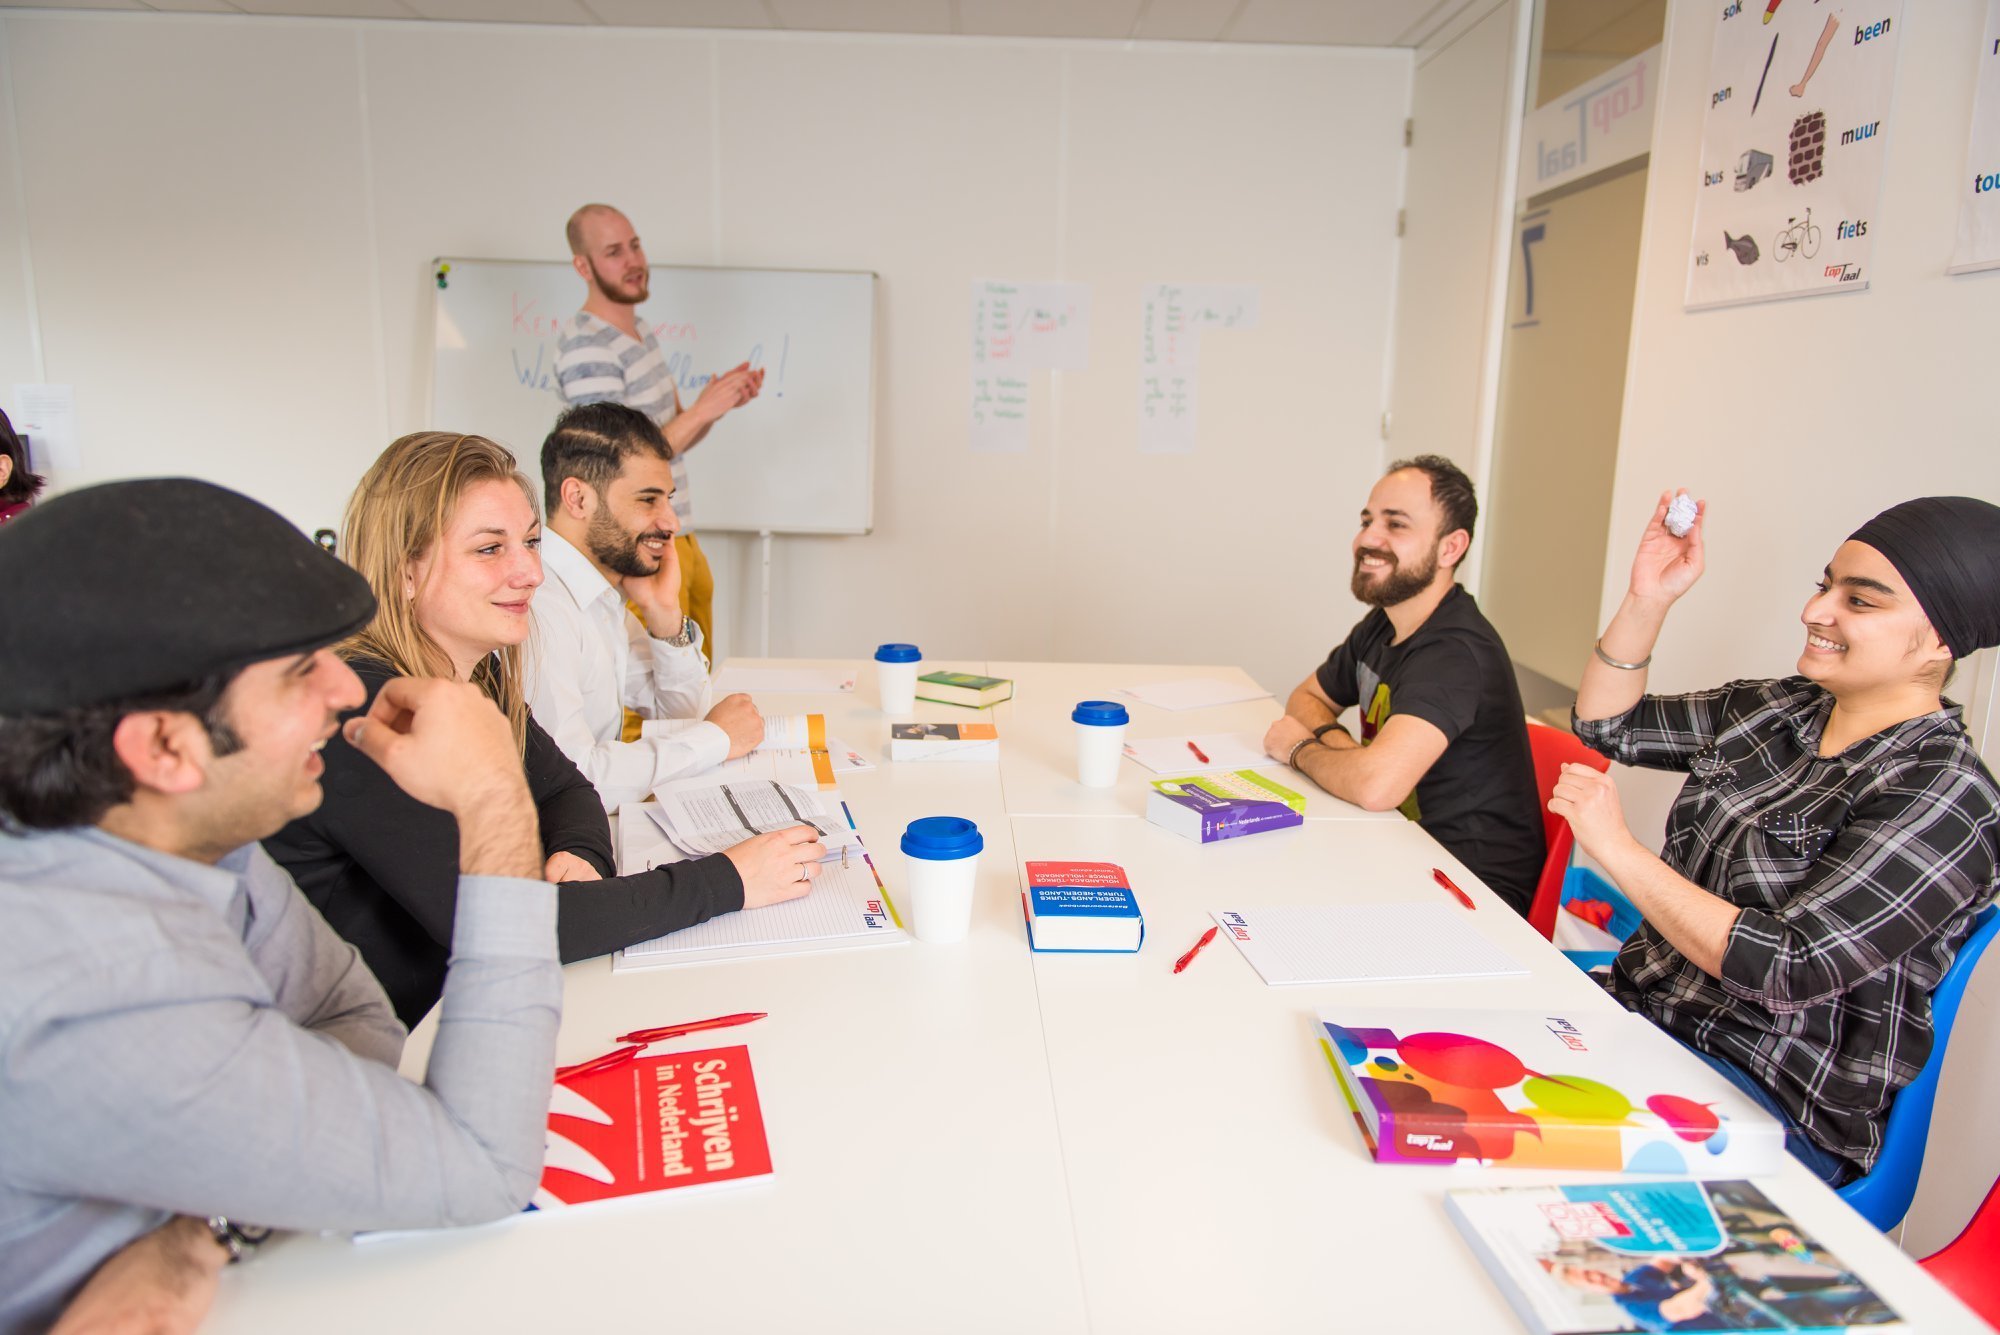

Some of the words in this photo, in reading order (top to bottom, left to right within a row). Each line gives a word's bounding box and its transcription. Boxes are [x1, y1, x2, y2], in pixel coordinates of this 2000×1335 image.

[1723, 0, 1742, 21] sok
[1854, 17, 1892, 46] been
[1712, 86, 1732, 110] pen
[1840, 120, 1881, 146] muur
[1704, 170, 1724, 187] bus
[1836, 219, 1868, 240] fiets
[1696, 252, 1710, 267] vis
[656, 1064, 682, 1082] in
[688, 1058, 739, 1172] Schrijven
[657, 1082, 693, 1178] Nederland
